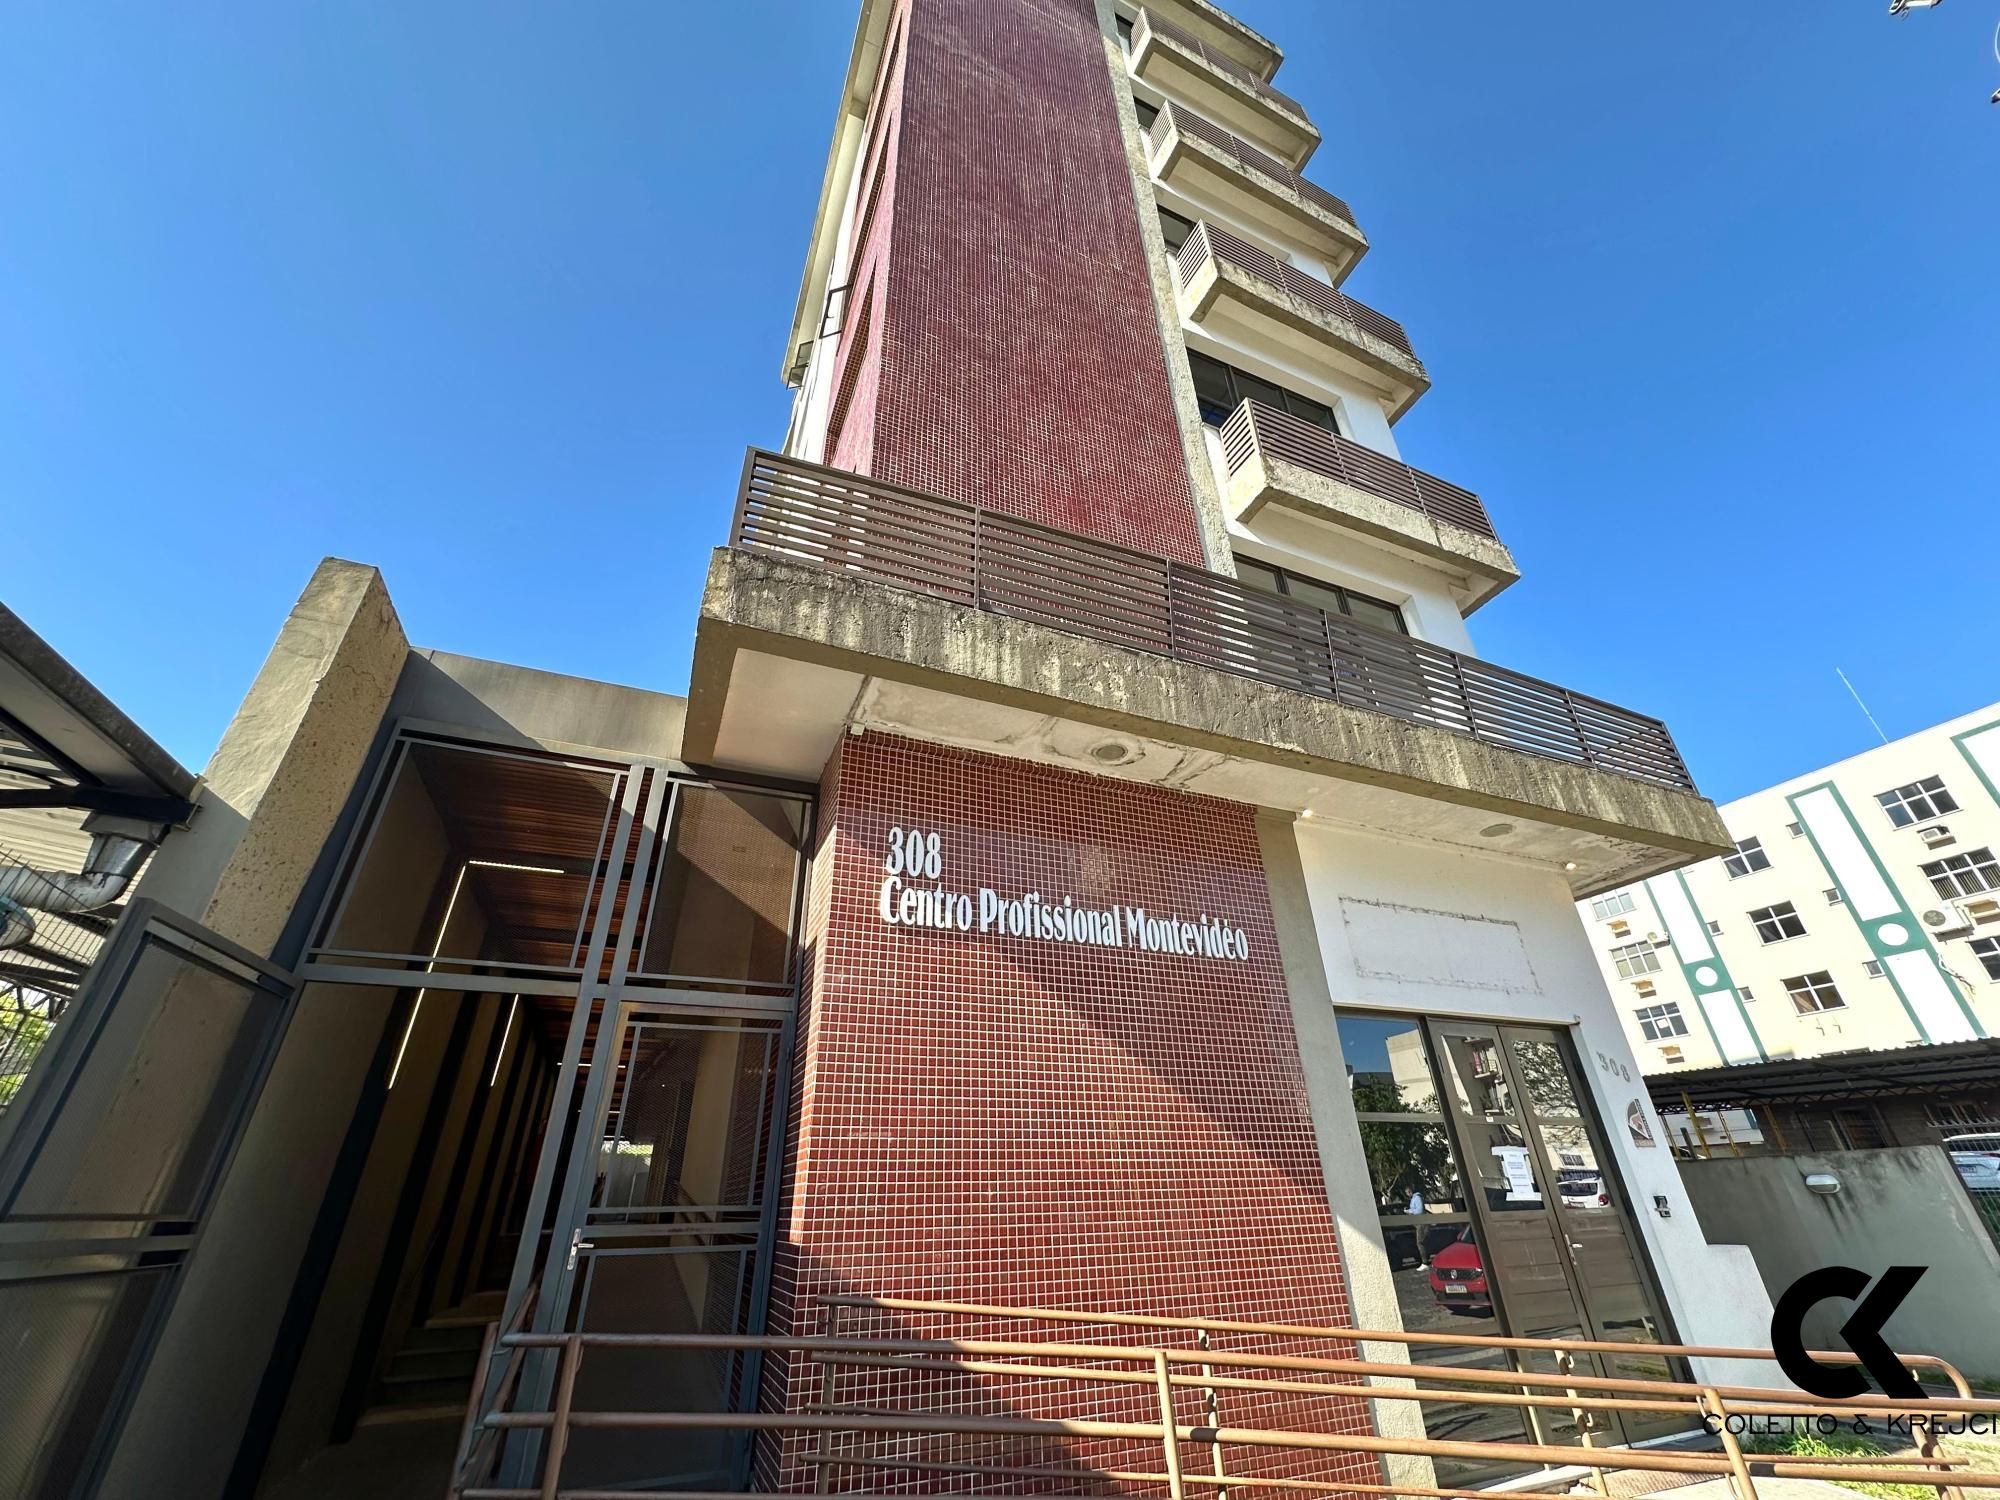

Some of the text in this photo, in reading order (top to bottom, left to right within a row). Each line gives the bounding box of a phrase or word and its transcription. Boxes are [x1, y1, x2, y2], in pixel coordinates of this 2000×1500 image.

[886, 826, 942, 879] 308
[880, 875, 973, 931] Centro
[979, 887, 1123, 948] Profissional
[1596, 1051, 1631, 1083] 308
